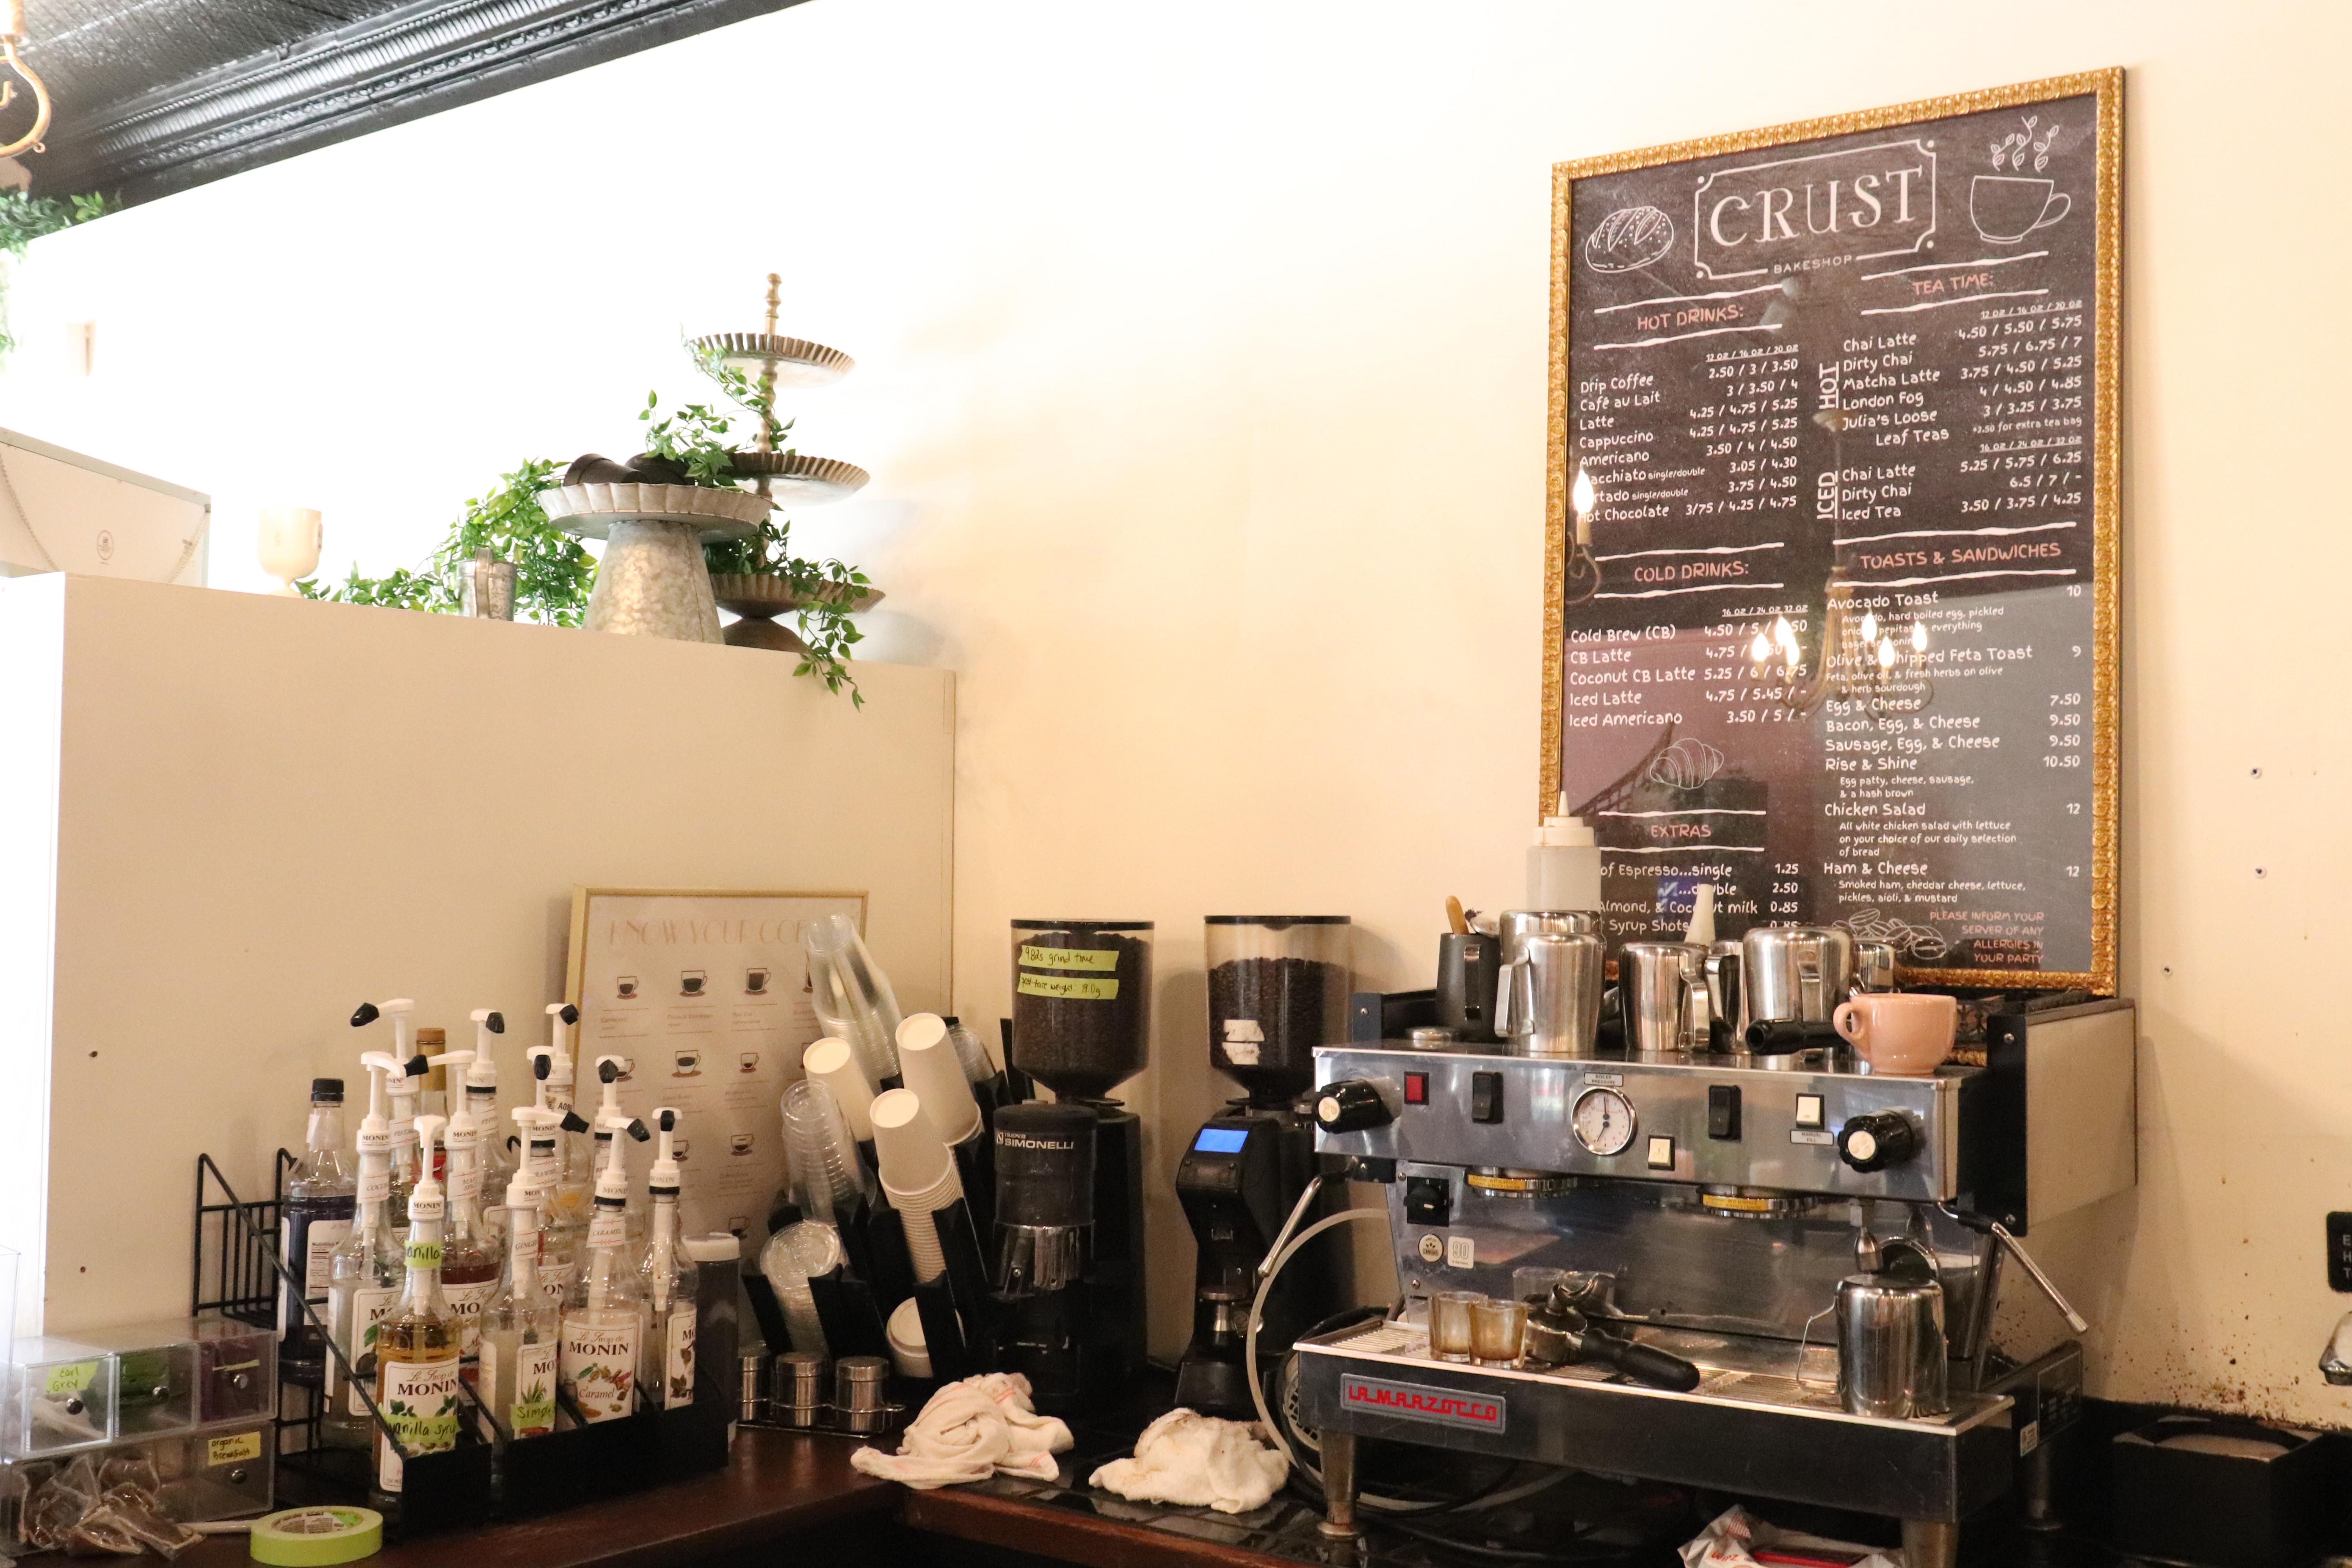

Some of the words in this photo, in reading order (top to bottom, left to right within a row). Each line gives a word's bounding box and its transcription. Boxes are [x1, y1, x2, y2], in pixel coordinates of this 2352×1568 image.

[1710, 164, 1922, 247] CRUST
[1774, 255, 1852, 274] BAKESHOP
[1912, 279, 1944, 295] TEA
[1950, 273, 1993, 290] TIME:
[1637, 313, 1671, 330] HOT
[1677, 305, 1743, 326] DRINKS:
[1844, 336, 1873, 352] Chai
[1878, 333, 1916, 348] Latte
[1844, 357, 1877, 374] Dirty
[1883, 351, 1912, 367] Chai
[1581, 382, 1606, 394] Drip
[1611, 373, 1653, 390] Coffee
[1709, 366, 1734, 378] 2.50
[1750, 364, 1756, 374] 3
[1772, 359, 1798, 372] 3.50
[1844, 373, 1896, 389] Matcha
[1902, 369, 1940, 385] Latte
[1961, 365, 1989, 379] 3.75
[2007, 360, 2035, 374] 4.50
[2054, 355, 2081, 369] 5.25
[1818, 363, 1835, 409] HOT
[1581, 396, 1609, 412] Café
[1635, 391, 1660, 406] Lait
[1844, 395, 1894, 410] London
[1899, 392, 1924, 407] Fog
[1580, 416, 1614, 430] Latte
[1842, 414, 1889, 430] Julia's
[1895, 410, 1937, 425] Loose
[1998, 421, 2012, 432] for
[2016, 420, 2041, 430] extra
[2063, 417, 2082, 426] bag
[1580, 431, 1654, 450] Cappuccino
[1876, 428, 1909, 446] Leaf
[1913, 429, 1949, 442] Teas
[1579, 452, 1649, 467] Americano
[1817, 472, 1835, 519] ICED
[1578, 510, 1600, 523] Hot
[1605, 505, 1669, 521] Chocolate
[1842, 507, 1870, 520] Iced
[1875, 506, 1901, 518] Tea
[1860, 552, 1927, 569] TOASTS
[1933, 552, 1945, 564] &
[1952, 543, 2061, 563] SANDWICHES
[1635, 566, 1675, 582] COLD
[1681, 561, 1748, 579] DRINKS:
[1827, 594, 1889, 610] Avocado
[1895, 591, 1938, 606] Toast
[2067, 586, 2081, 596] 10
[1572, 628, 1601, 643] Cold
[1607, 629, 1640, 641] Brew
[1646, 624, 1675, 640] (CB)
[1827, 654, 1861, 668] Olive
[1950, 648, 1981, 662] Feta
[1987, 645, 2032, 660] Toast
[2073, 646, 2081, 657] 9
[1570, 669, 1627, 685] Coconut
[1633, 670, 1651, 682] CB
[1656, 667, 1695, 682] Latte
[1826, 700, 1850, 716] Egg
[1856, 701, 1866, 711] &
[1872, 697, 1921, 710] Cheese
[2051, 693, 2080, 706] 7.50
[1570, 714, 1597, 727] Iced
[1602, 711, 1682, 726] Americano
[1826, 720, 1873, 732] Bacon,
[1879, 719, 1907, 734] Egg,
[1913, 718, 1924, 729] &
[1929, 715, 1980, 728] Cheese
[2050, 714, 2080, 726] 9.50
[1826, 757, 1856, 771] Rise
[1862, 759, 1872, 770] &
[1878, 756, 1917, 769] Shine
[2043, 755, 2080, 767] 10.50
[1825, 802, 1877, 816] Chicken
[1883, 803, 1925, 815] Salad
[2067, 804, 2080, 814] 12
[1651, 824, 1711, 837] EXTRAS
[1856, 822, 1880, 831] white
[1884, 821, 1918, 830] chicken
[1922, 822, 1949, 830] salad
[1952, 821, 1972, 830] with
[1976, 821, 2010, 829] lettuce
[1775, 864, 1798, 874] 1.25
[1824, 863, 1856, 874] Ham
[1862, 863, 1872, 874] &
[1878, 861, 1927, 875] Cheese
[2066, 866, 2079, 877] 12
[1773, 883, 1798, 893] 2.50
[1728, 900, 1757, 913] milk
[1771, 901, 1797, 913] 0.85
[1930, 910, 1967, 920] PLEASE
[1972, 911, 2010, 921] INFORM
[2014, 912, 2044, 921] YOUR
[609, 920, 676, 945] KNOW
[1610, 919, 1646, 935] Syrup
[1962, 925, 2002, 934] SERVER
[2005, 926, 2018, 935] OF
[2022, 927, 2043, 935] ANY
[1974, 939, 2030, 949] ALLERGIES
[2033, 940, 2043, 950] IN
[1047, 952, 1071, 966] grind
[1074, 953, 1094, 964] time
[1975, 953, 2004, 962] YOUR
[2007, 953, 2044, 963] PARTY
[1004, 1138, 1074, 1150] SIMONELLI
[405, 1246, 440, 1261] anilla
[1452, 1241, 1469, 1259] 90
[569, 1341, 628, 1356] MONIN
[397, 1377, 458, 1396] MONIN
[578, 1387, 615, 1399] Caramel
